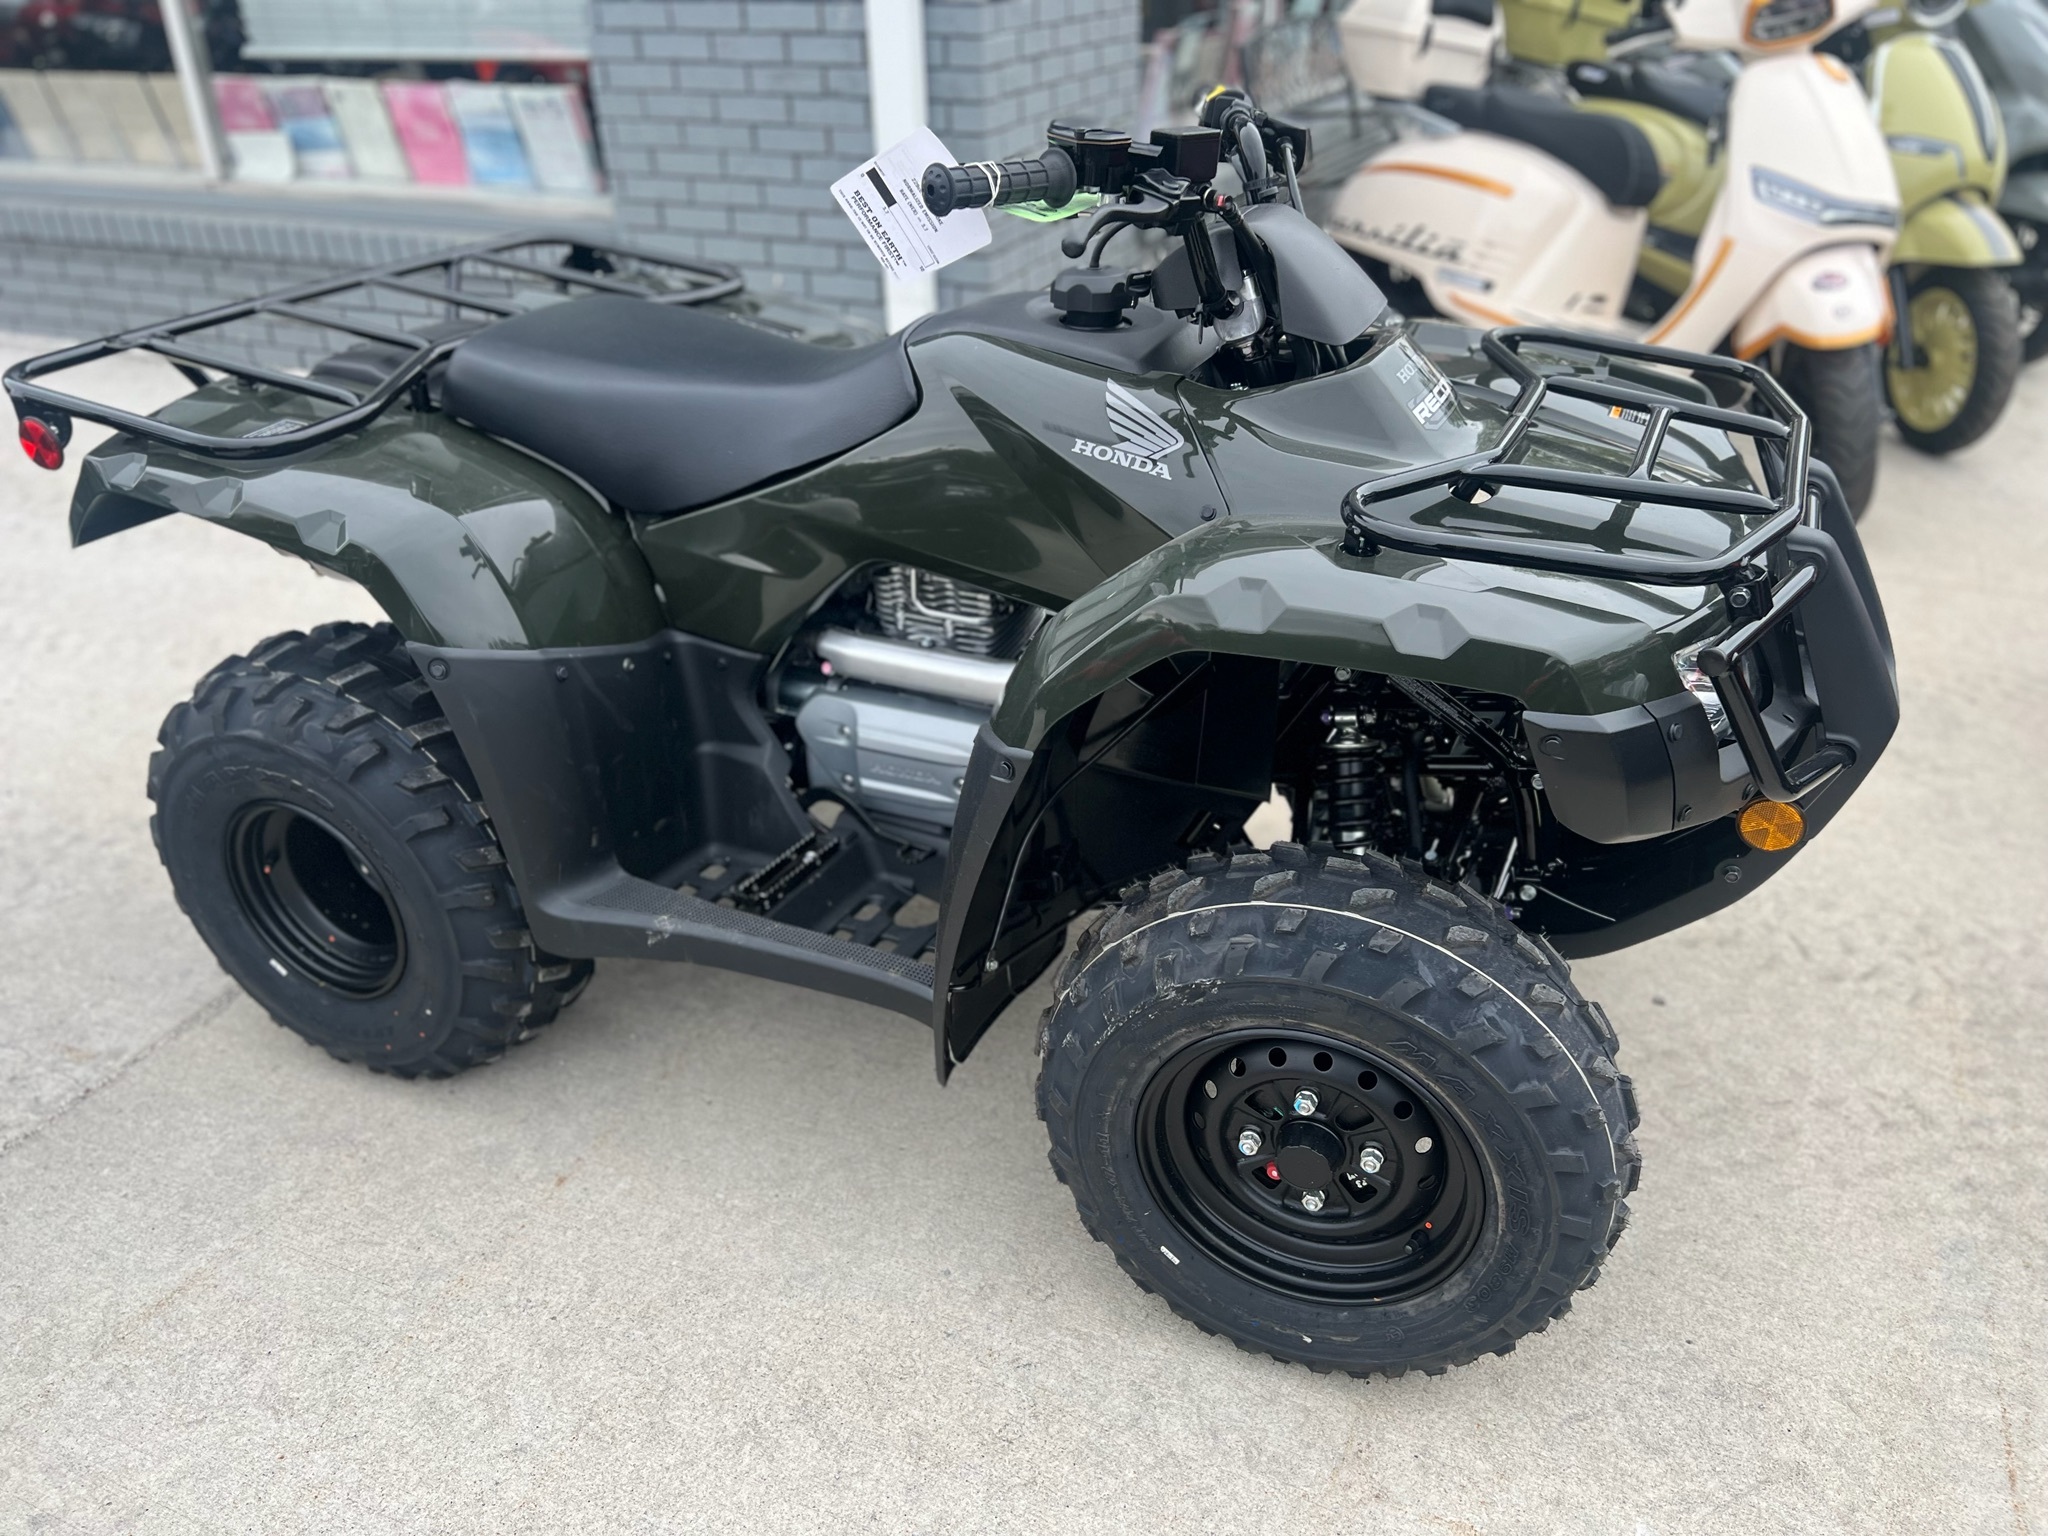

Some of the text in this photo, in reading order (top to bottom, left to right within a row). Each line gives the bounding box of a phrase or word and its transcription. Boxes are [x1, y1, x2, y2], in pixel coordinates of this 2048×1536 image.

[851, 195, 883, 241] PERFORMANCE
[853, 189, 873, 216] BEST
[871, 215, 883, 229] ON
[1071, 438, 1172, 480] HONDA
[1386, 1041, 1530, 1236] MAXXIS
